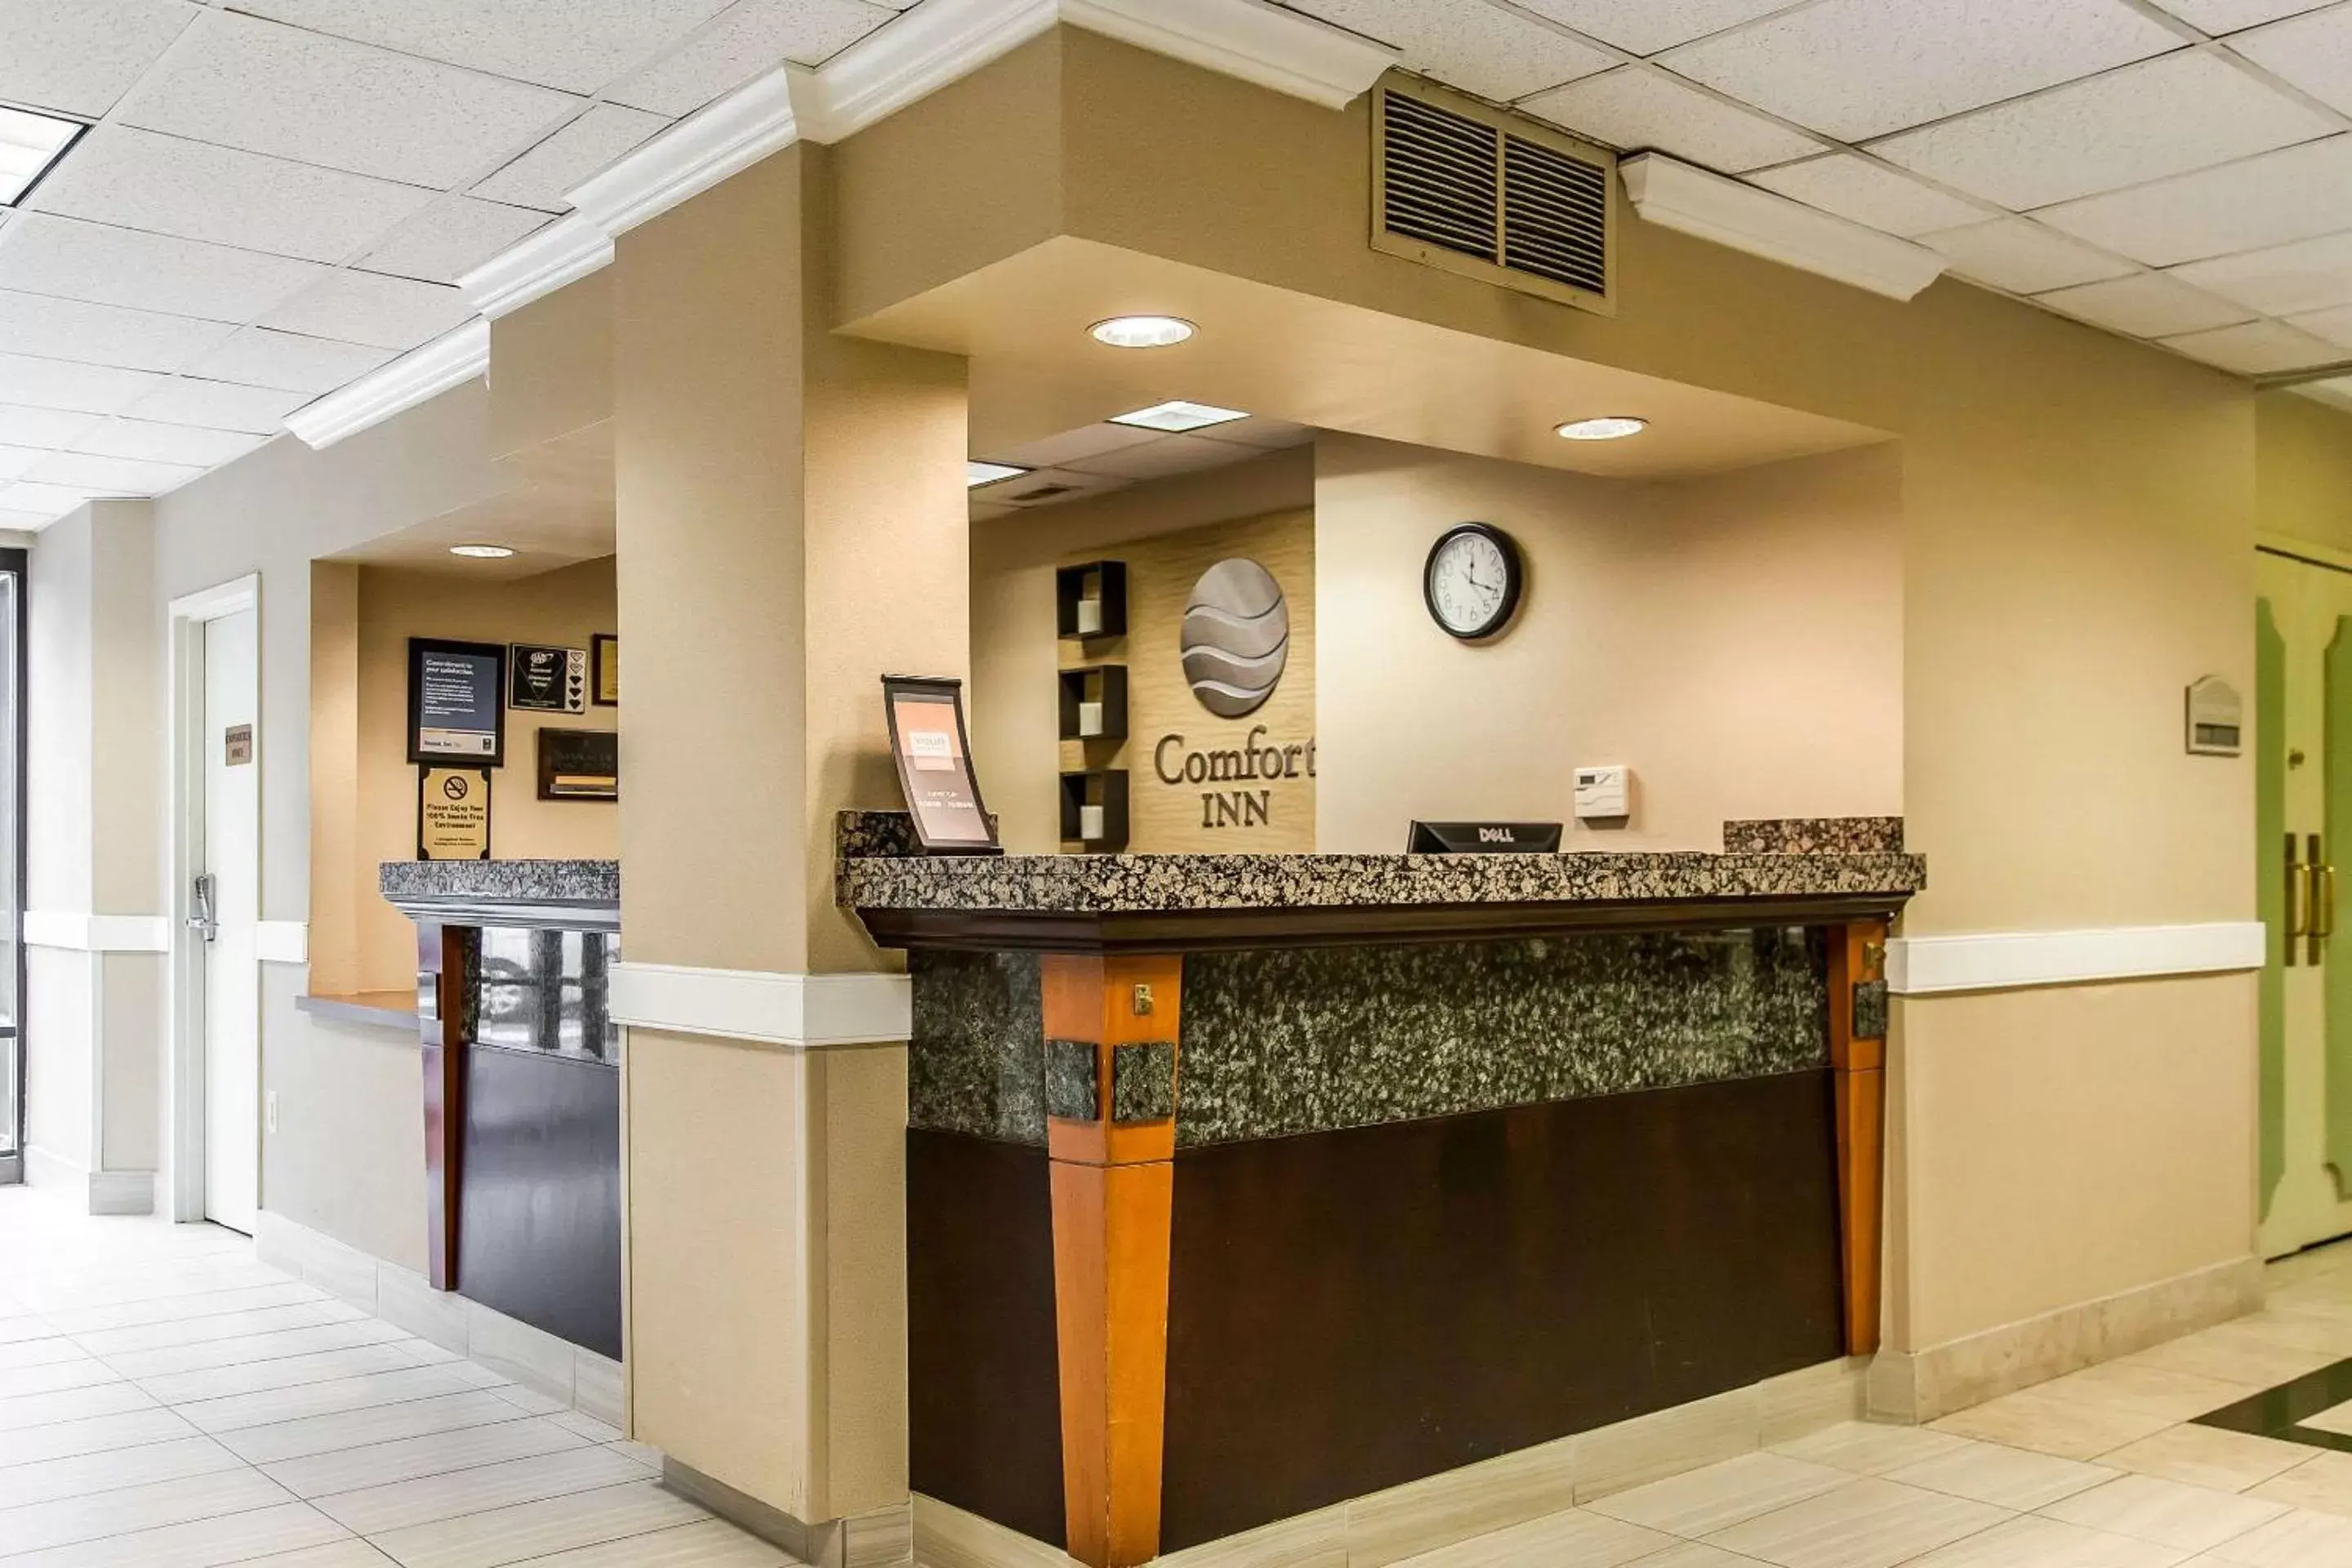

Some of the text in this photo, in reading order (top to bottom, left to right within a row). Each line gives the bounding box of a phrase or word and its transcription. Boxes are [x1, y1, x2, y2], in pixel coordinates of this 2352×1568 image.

[1470, 605, 1478, 621] 6
[1482, 599, 1492, 615] 5
[1155, 724, 1316, 785] Comfort
[1202, 790, 1271, 828] INN
[1478, 827, 1515, 843] DELL
